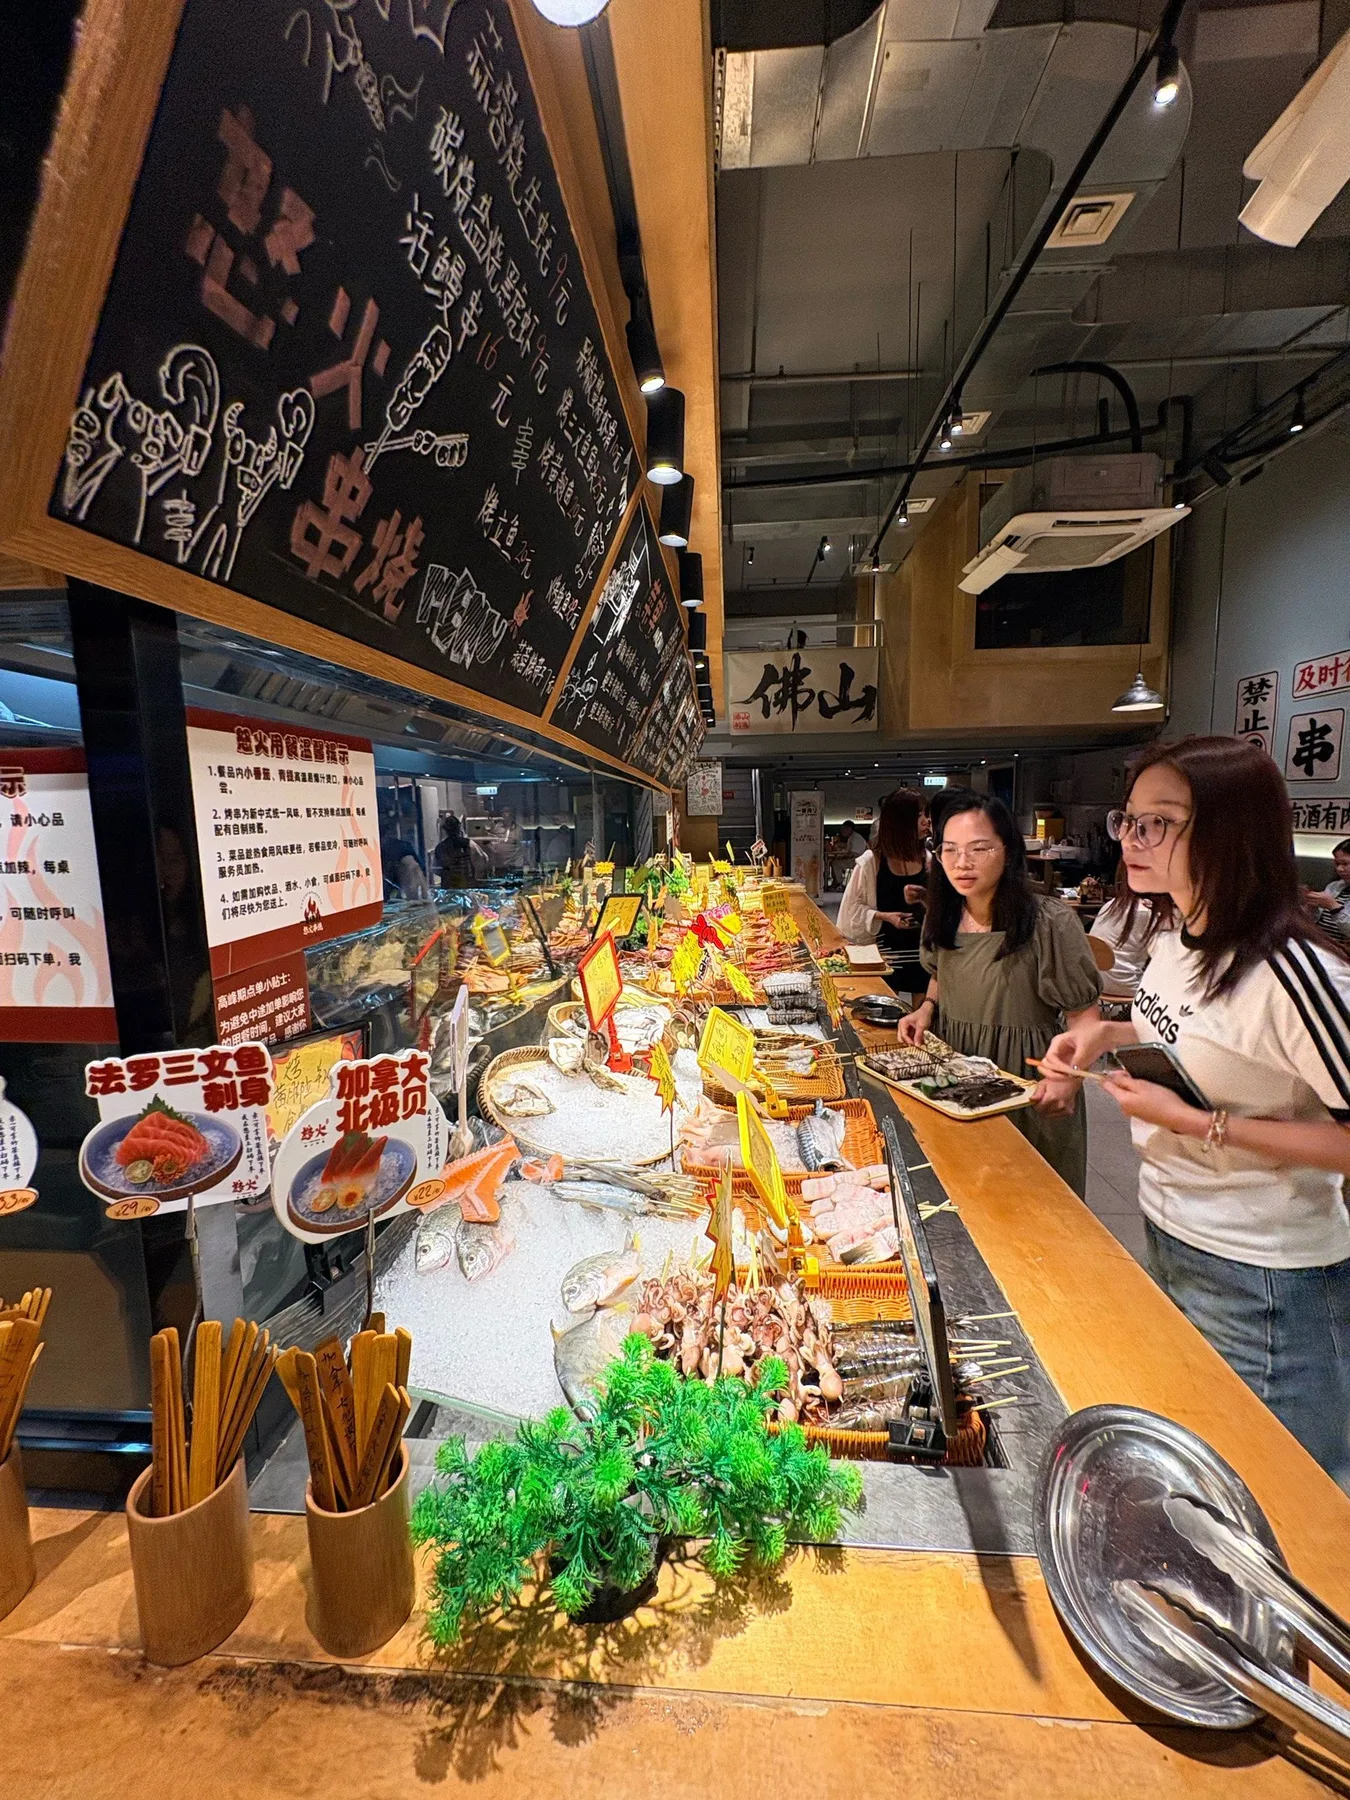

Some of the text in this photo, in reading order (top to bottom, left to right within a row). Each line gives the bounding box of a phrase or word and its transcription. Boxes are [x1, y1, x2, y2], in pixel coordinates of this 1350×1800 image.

[490, 374, 516, 429] 元
[290, 446, 426, 624] 串烧
[730, 652, 878, 732] 佛山
[1237, 677, 1273, 735] 禁止
[1291, 717, 1335, 777] 串
[0, 860, 70, 875] 加辣，每桌
[0, 952, 82, 967] 扫码下单，我
[1133, 987, 1180, 1045] adidas
[88, 1046, 270, 1097] 法罗三文鱼
[203, 1077, 271, 1112] 刺身
[336, 1053, 428, 1101] 加拿大
[335, 1083, 428, 1133] 北极贝
